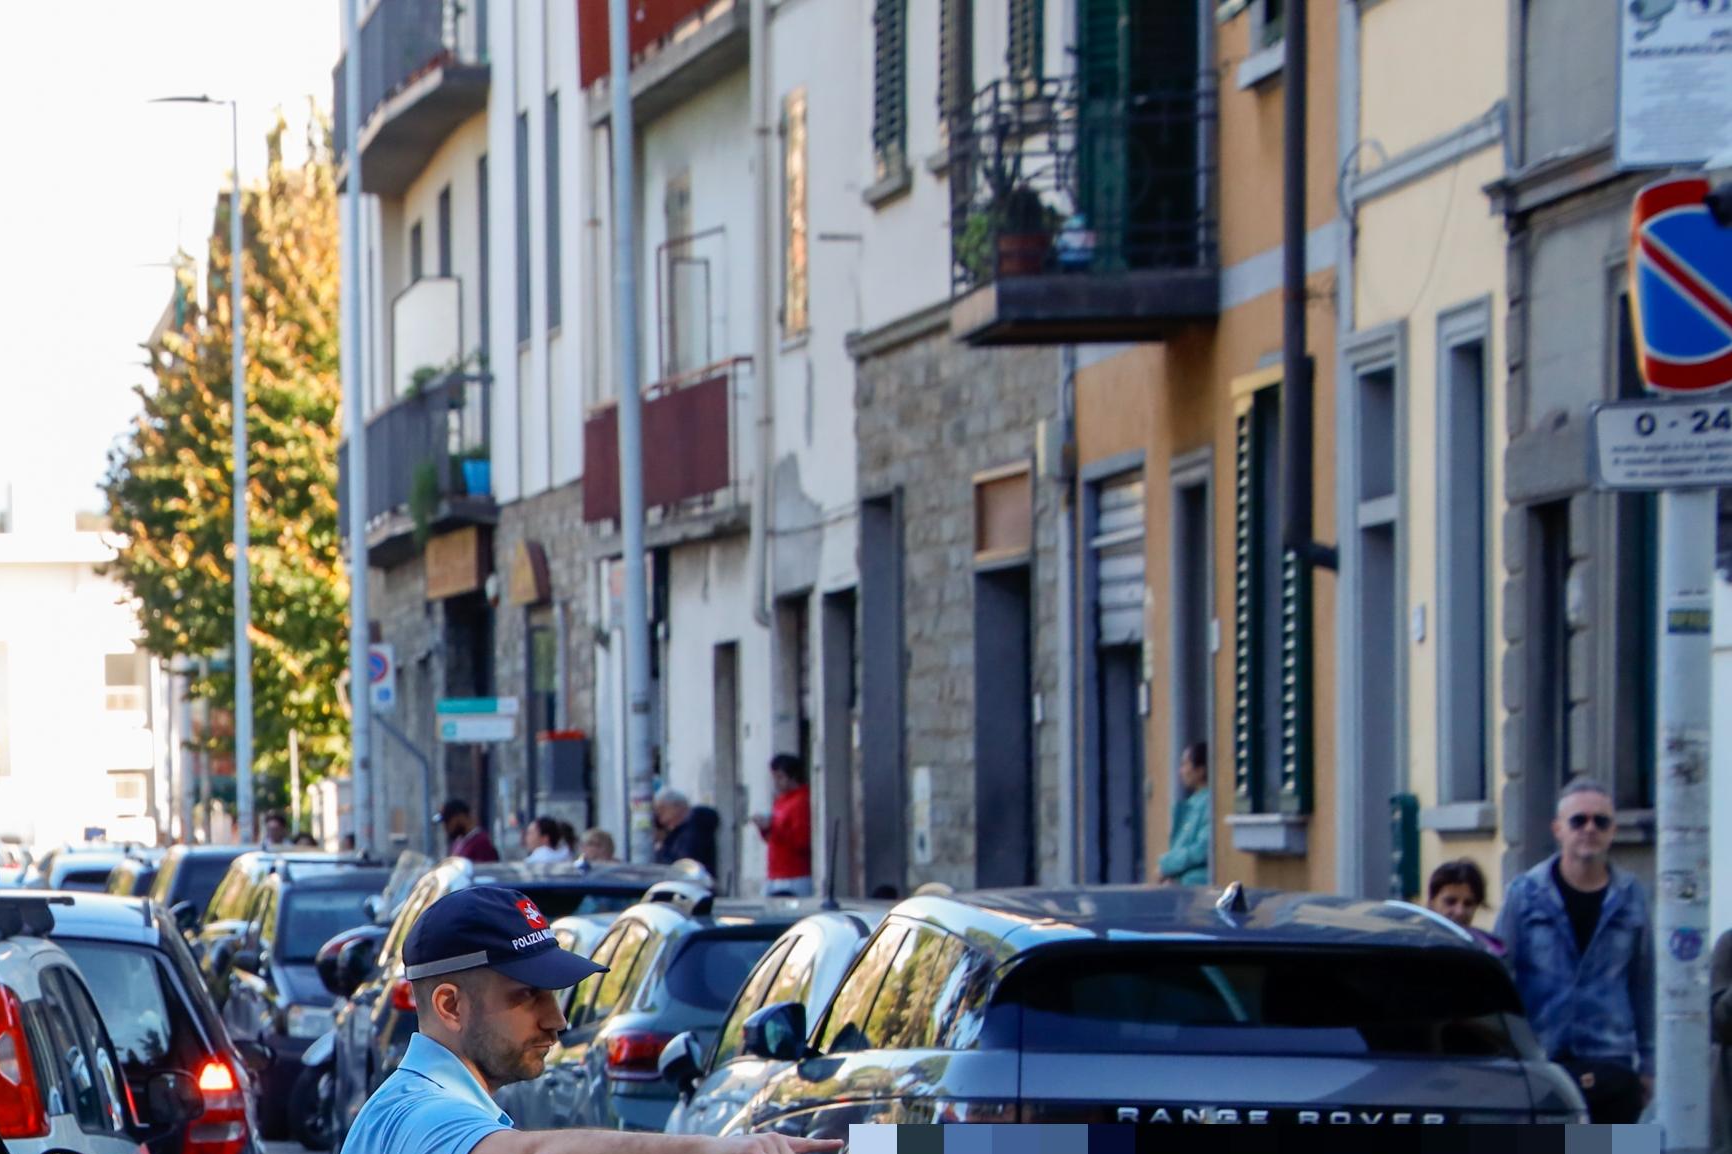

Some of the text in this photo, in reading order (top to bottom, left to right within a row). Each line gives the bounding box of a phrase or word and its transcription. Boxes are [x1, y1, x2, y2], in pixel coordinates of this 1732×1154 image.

[1690, 408, 1731, 434] 24
[511, 930, 545, 950] POLIZIA
[1117, 1107, 1444, 1124] RANGE ROVER
